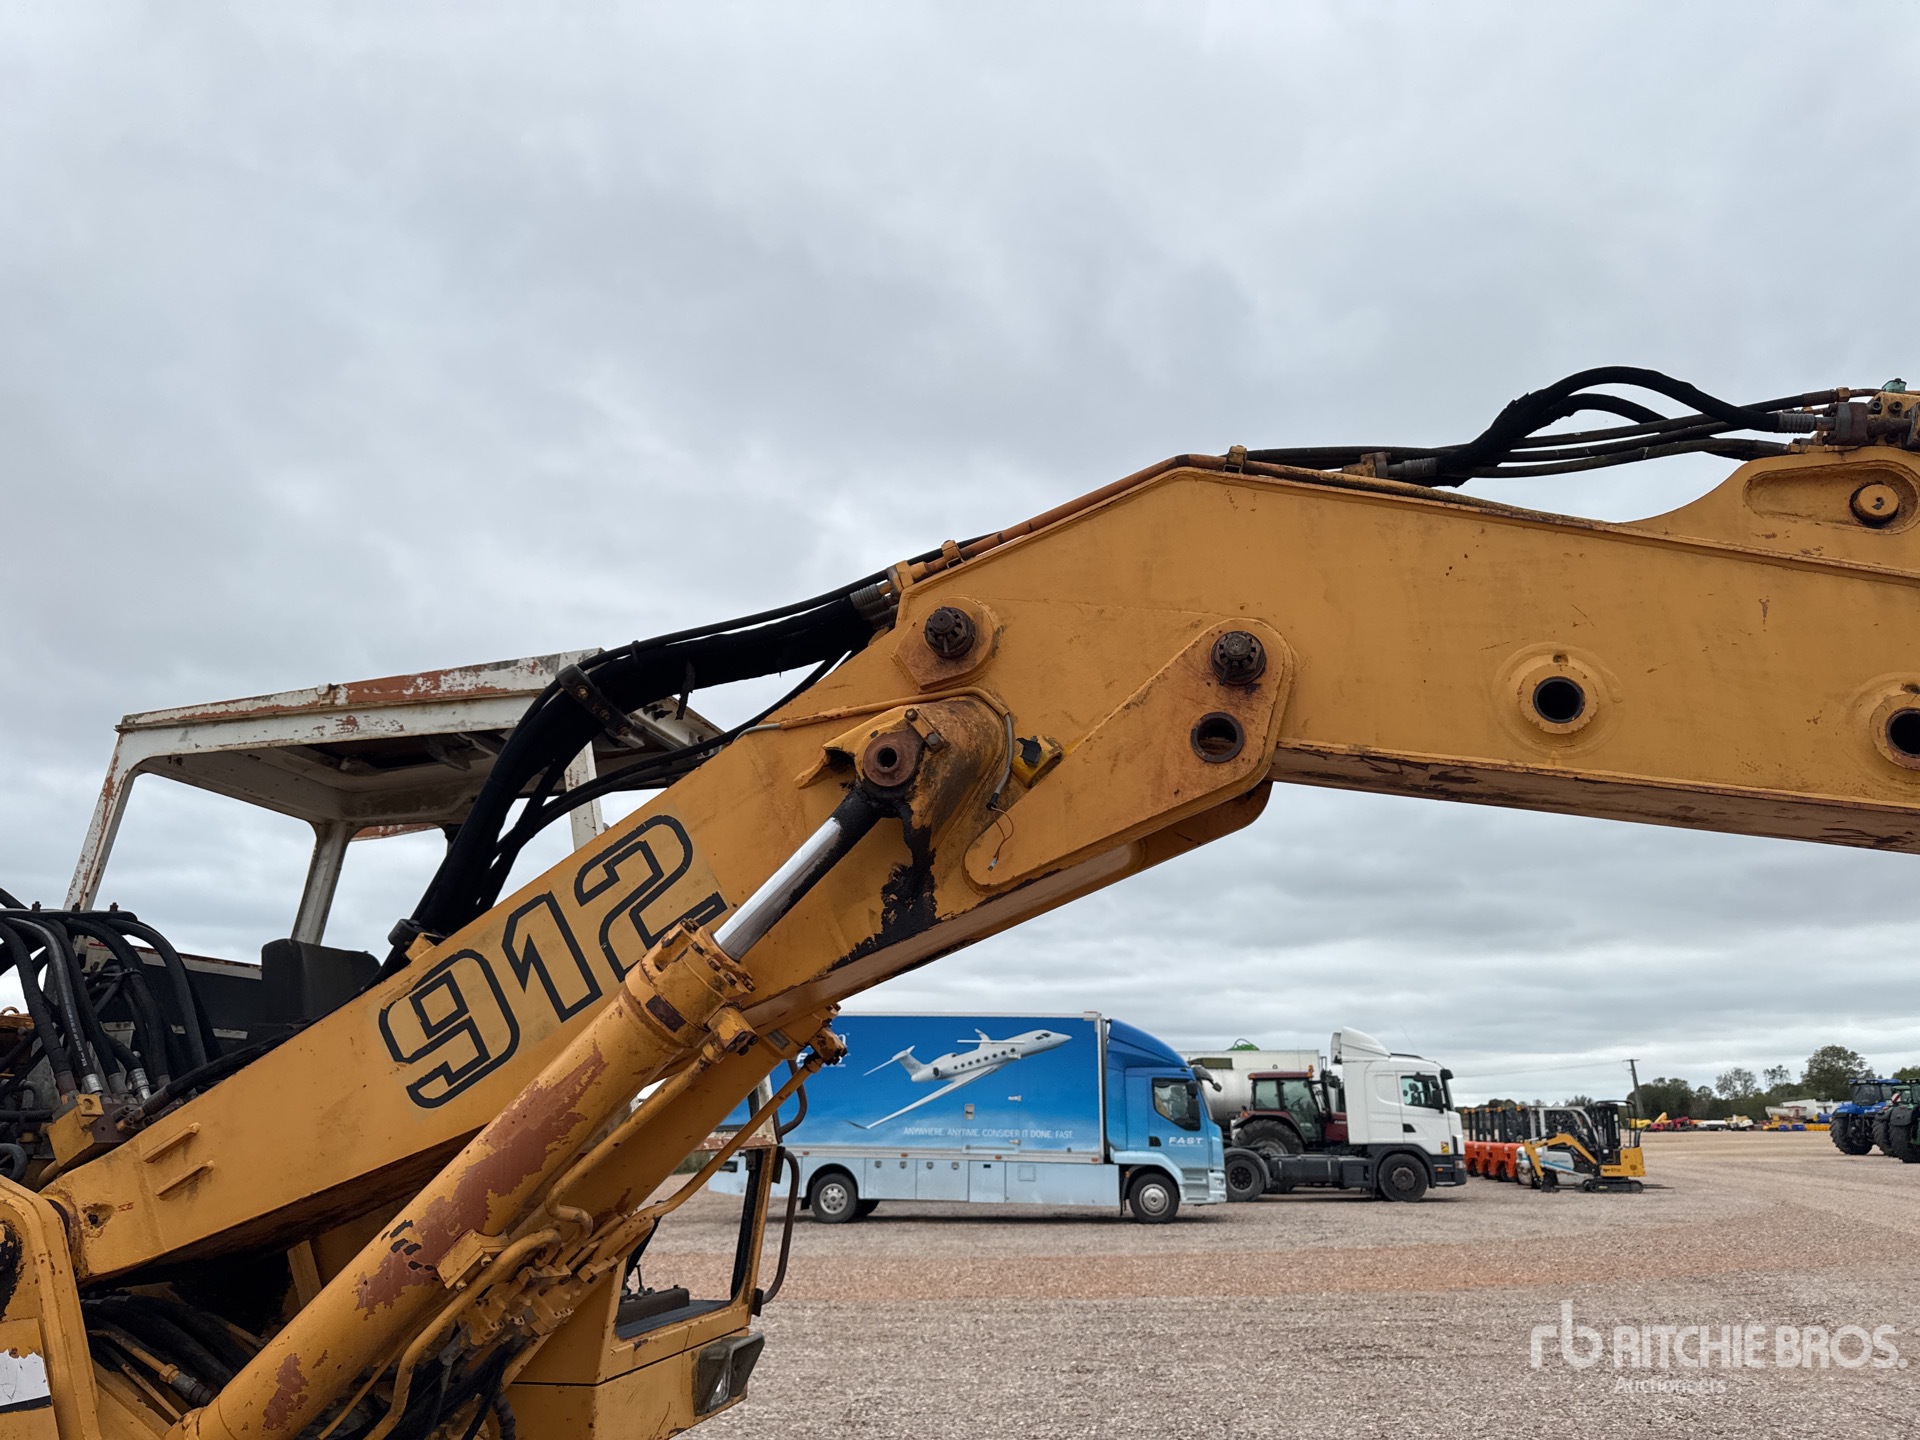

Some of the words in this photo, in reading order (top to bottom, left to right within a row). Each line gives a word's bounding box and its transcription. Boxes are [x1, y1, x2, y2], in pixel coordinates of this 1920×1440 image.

[378, 815, 728, 1108] 912
[982, 1128, 1020, 1138] CONSIDER
[1022, 1129, 1029, 1138] IT
[1168, 1136, 1203, 1145] FAST
